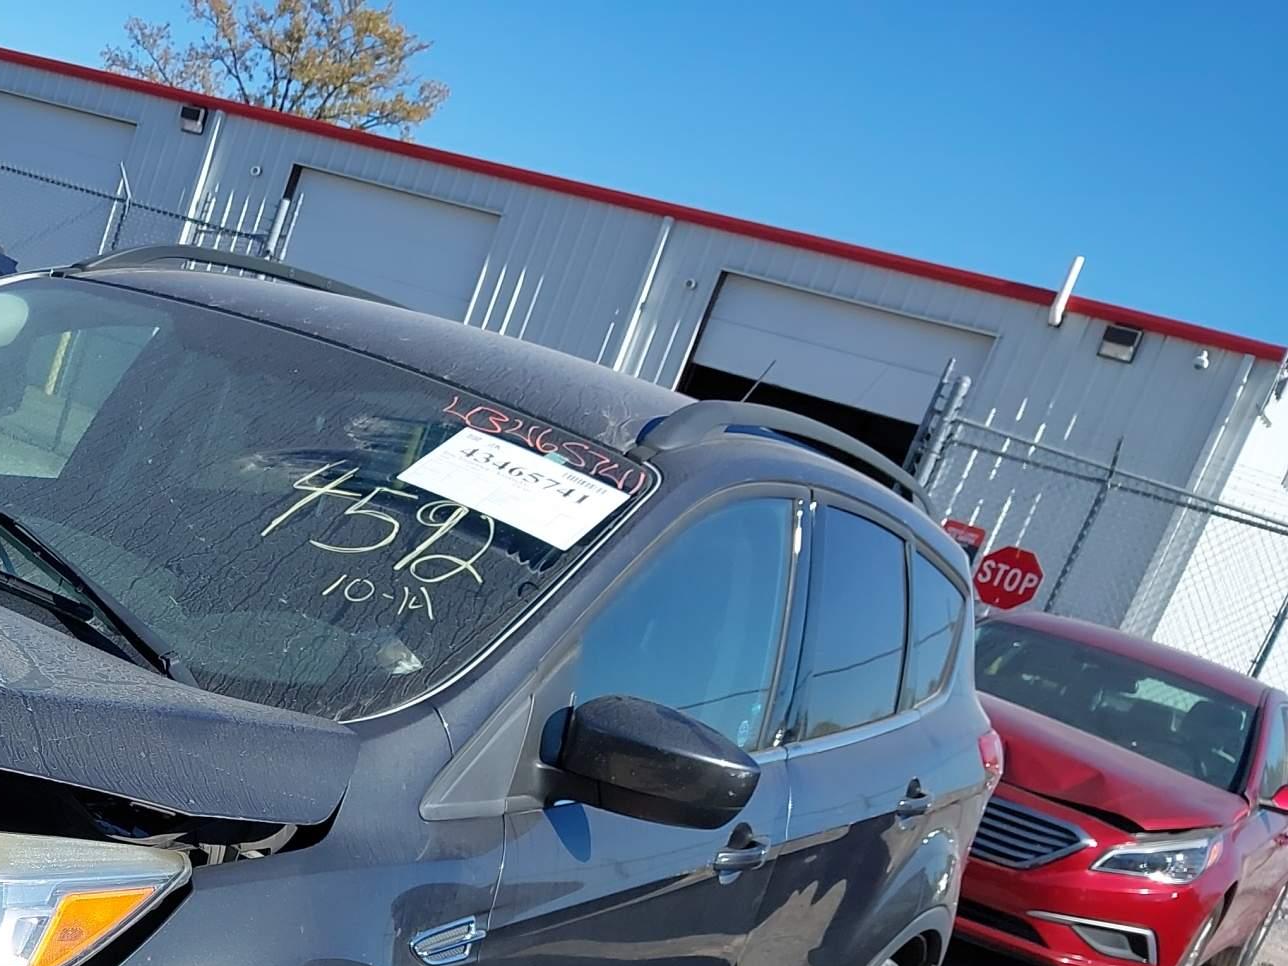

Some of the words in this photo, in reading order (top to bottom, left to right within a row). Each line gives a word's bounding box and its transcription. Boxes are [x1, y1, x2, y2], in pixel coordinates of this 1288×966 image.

[460, 447, 591, 504] 43465741
[261, 459, 495, 584] 4592
[977, 559, 1039, 595] STOP
